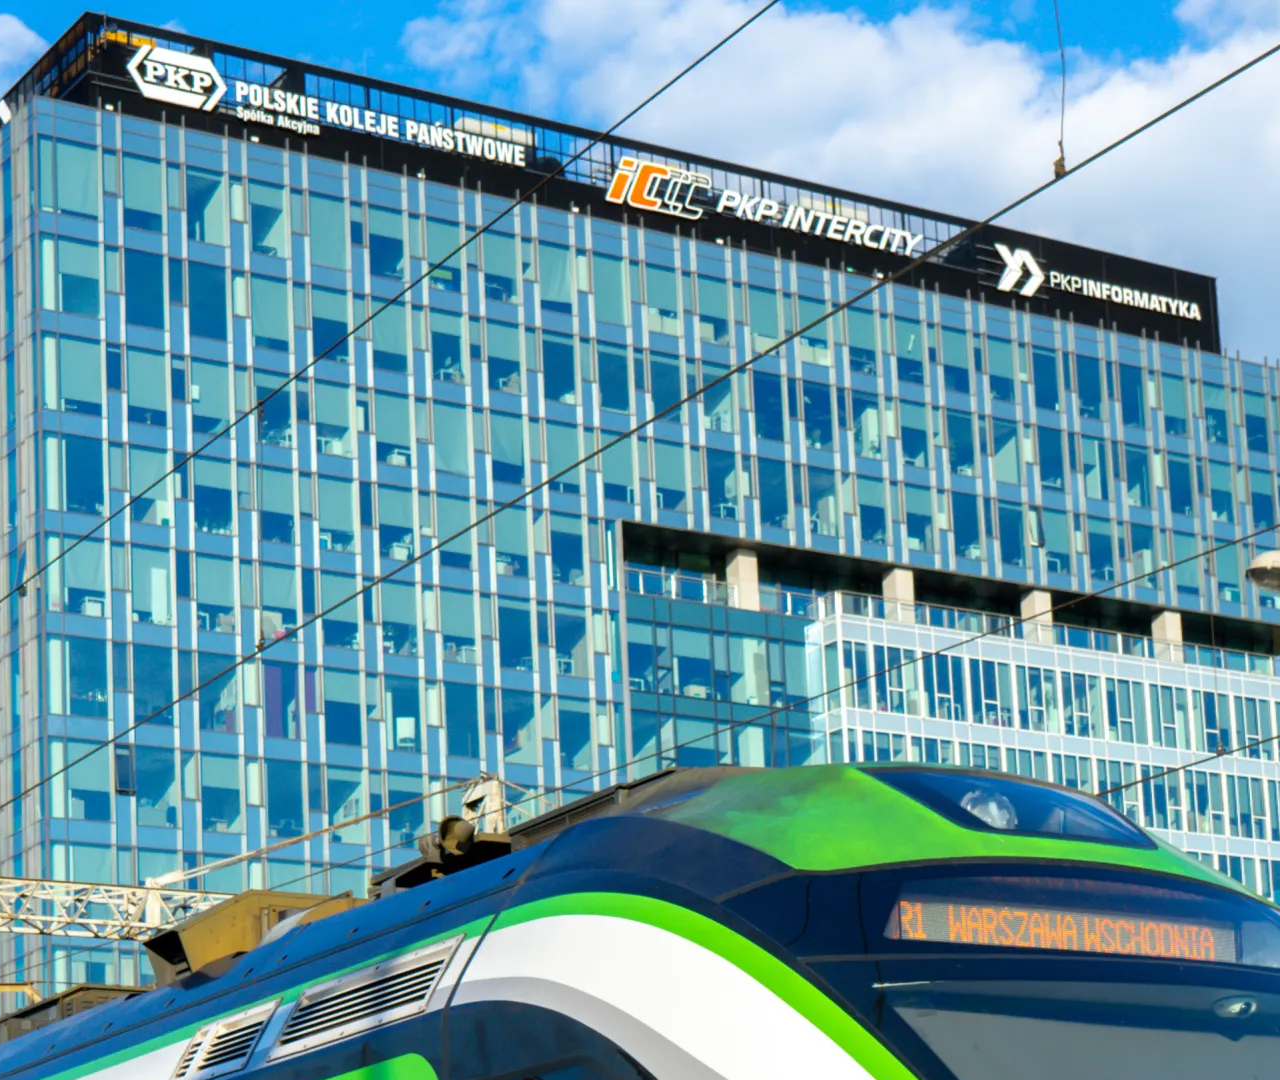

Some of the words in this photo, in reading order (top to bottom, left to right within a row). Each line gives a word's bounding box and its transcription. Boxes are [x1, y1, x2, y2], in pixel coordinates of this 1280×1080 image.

[144, 62, 213, 94] PKP
[235, 80, 320, 120] POLSKIE
[325, 101, 401, 139] KOLEJE
[405, 120, 526, 168] PAŃSTWOWE
[236, 106, 274, 126] Spółka
[276, 115, 321, 136] Akcyjna
[717, 188, 779, 224] PKP
[782, 205, 924, 257] INTERCITY
[947, 903, 1079, 951] WARSZAWA
[1082, 915, 1216, 963] WSCHODNIA
